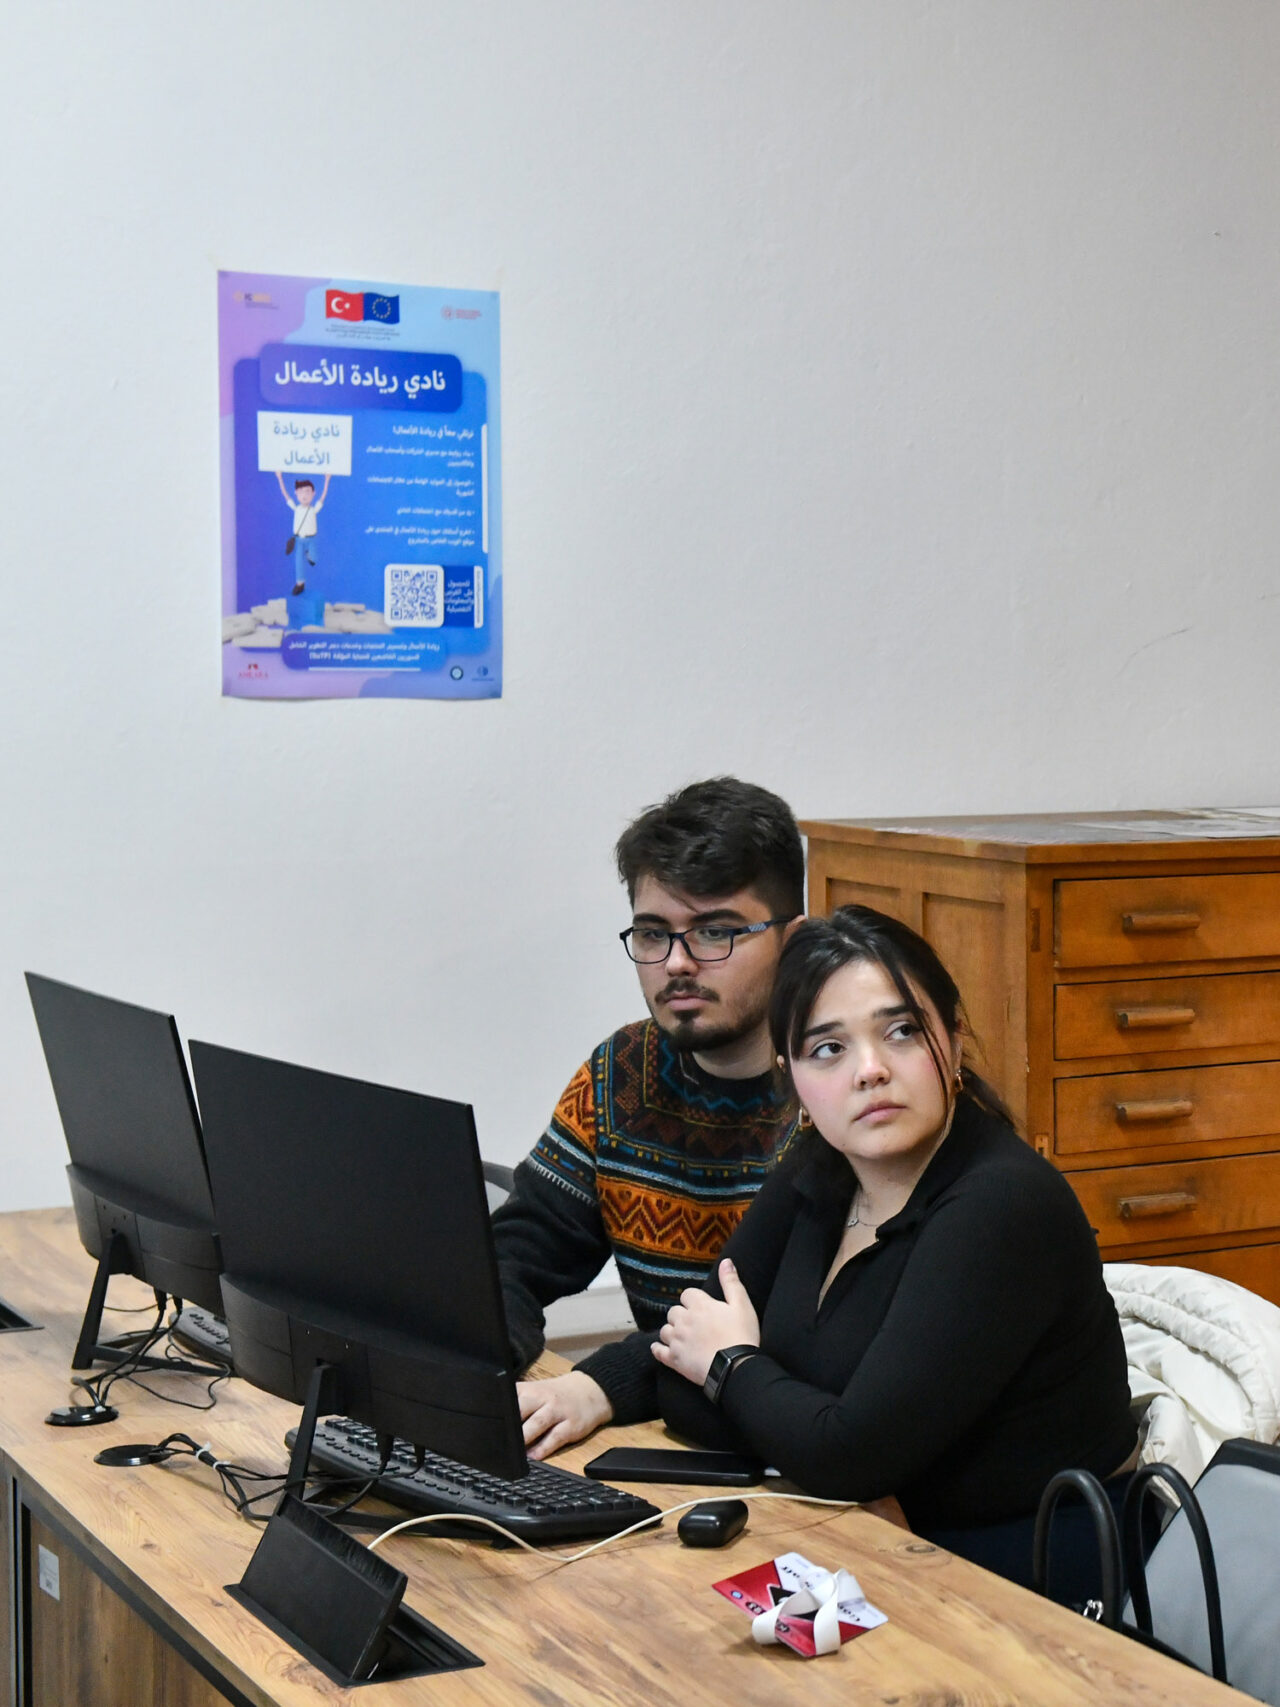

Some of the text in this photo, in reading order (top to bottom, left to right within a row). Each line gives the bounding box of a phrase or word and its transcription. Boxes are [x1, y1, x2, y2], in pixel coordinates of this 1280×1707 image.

[275, 358, 445, 399] نادي ريادة الأعمال
[273, 420, 340, 443] نادي ريادة
[284, 448, 330, 466] الأعمال
